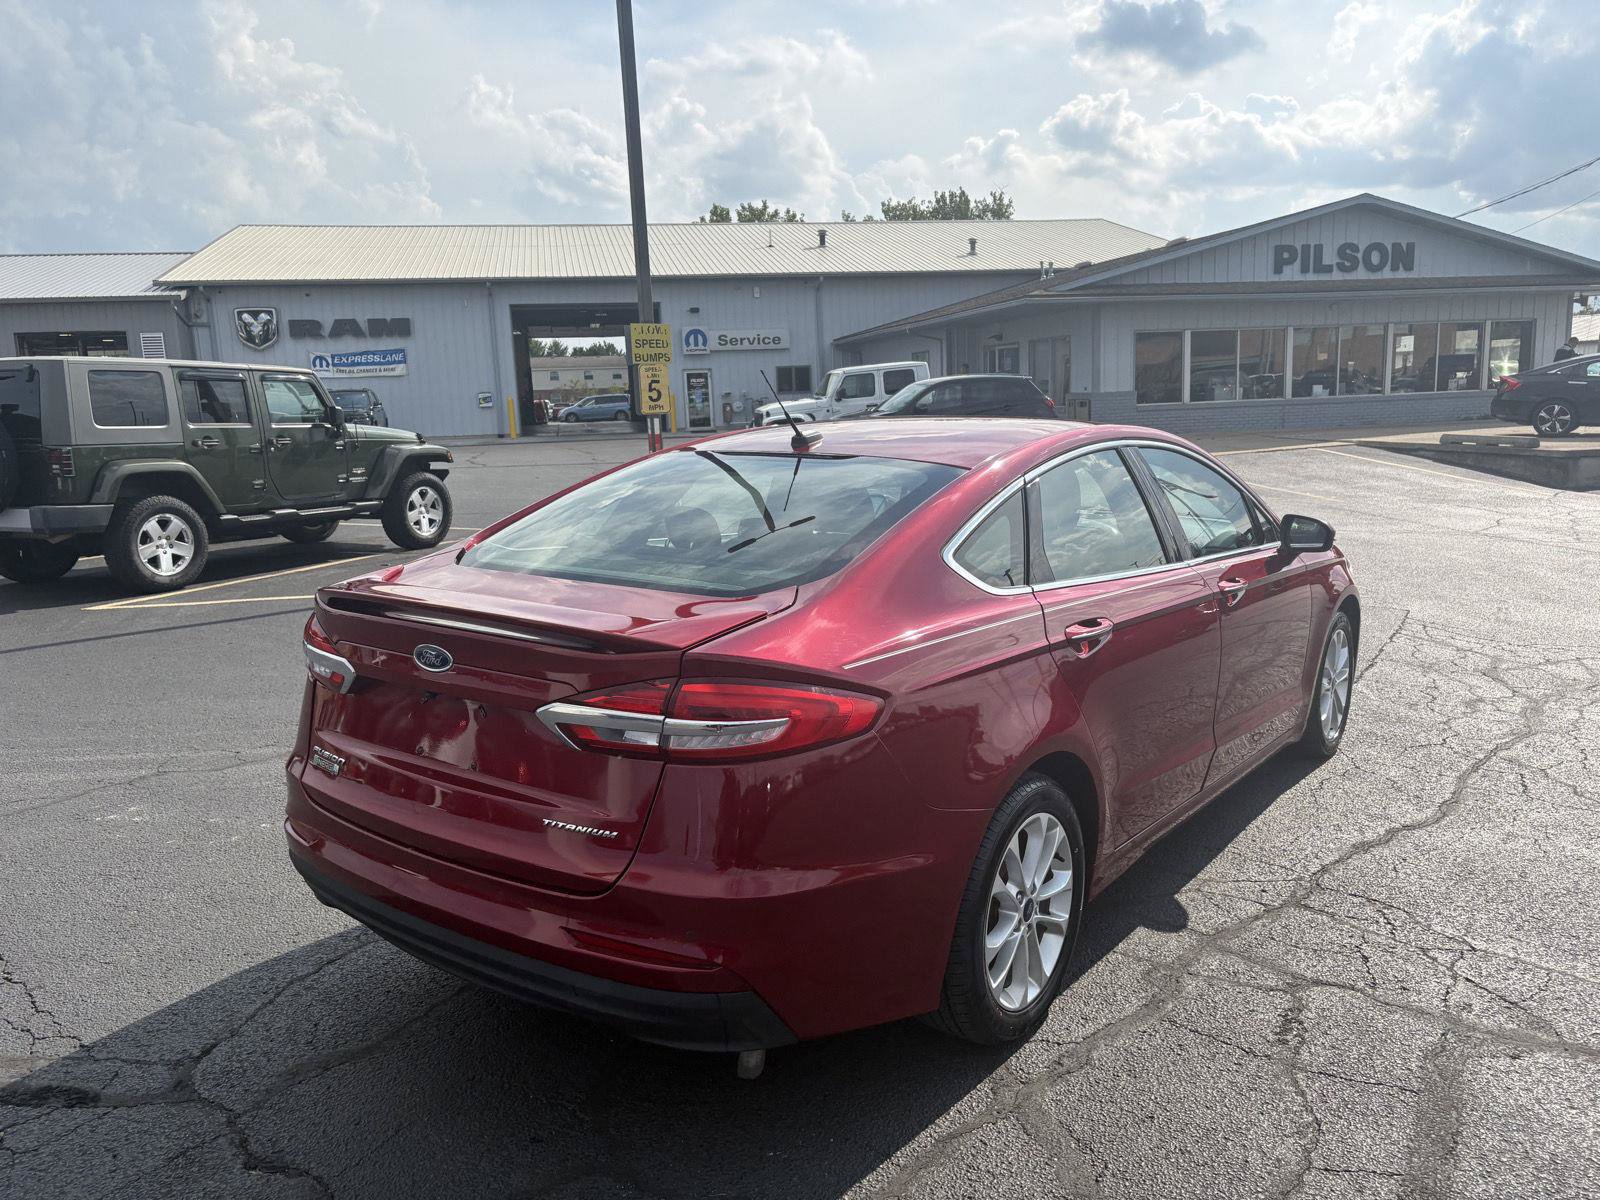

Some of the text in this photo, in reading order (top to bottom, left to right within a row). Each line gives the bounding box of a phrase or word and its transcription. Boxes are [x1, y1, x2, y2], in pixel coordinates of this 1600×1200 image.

[1273, 242, 1416, 275] PILSON
[288, 318, 411, 338] RAM
[635, 339, 669, 349] SPEED
[717, 334, 782, 347] Service
[635, 353, 671, 362] BUMPS
[648, 379, 662, 402] 5
[419, 649, 442, 666] Ford
[313, 745, 346, 764] FUSION
[542, 818, 619, 839] TITANIUM
